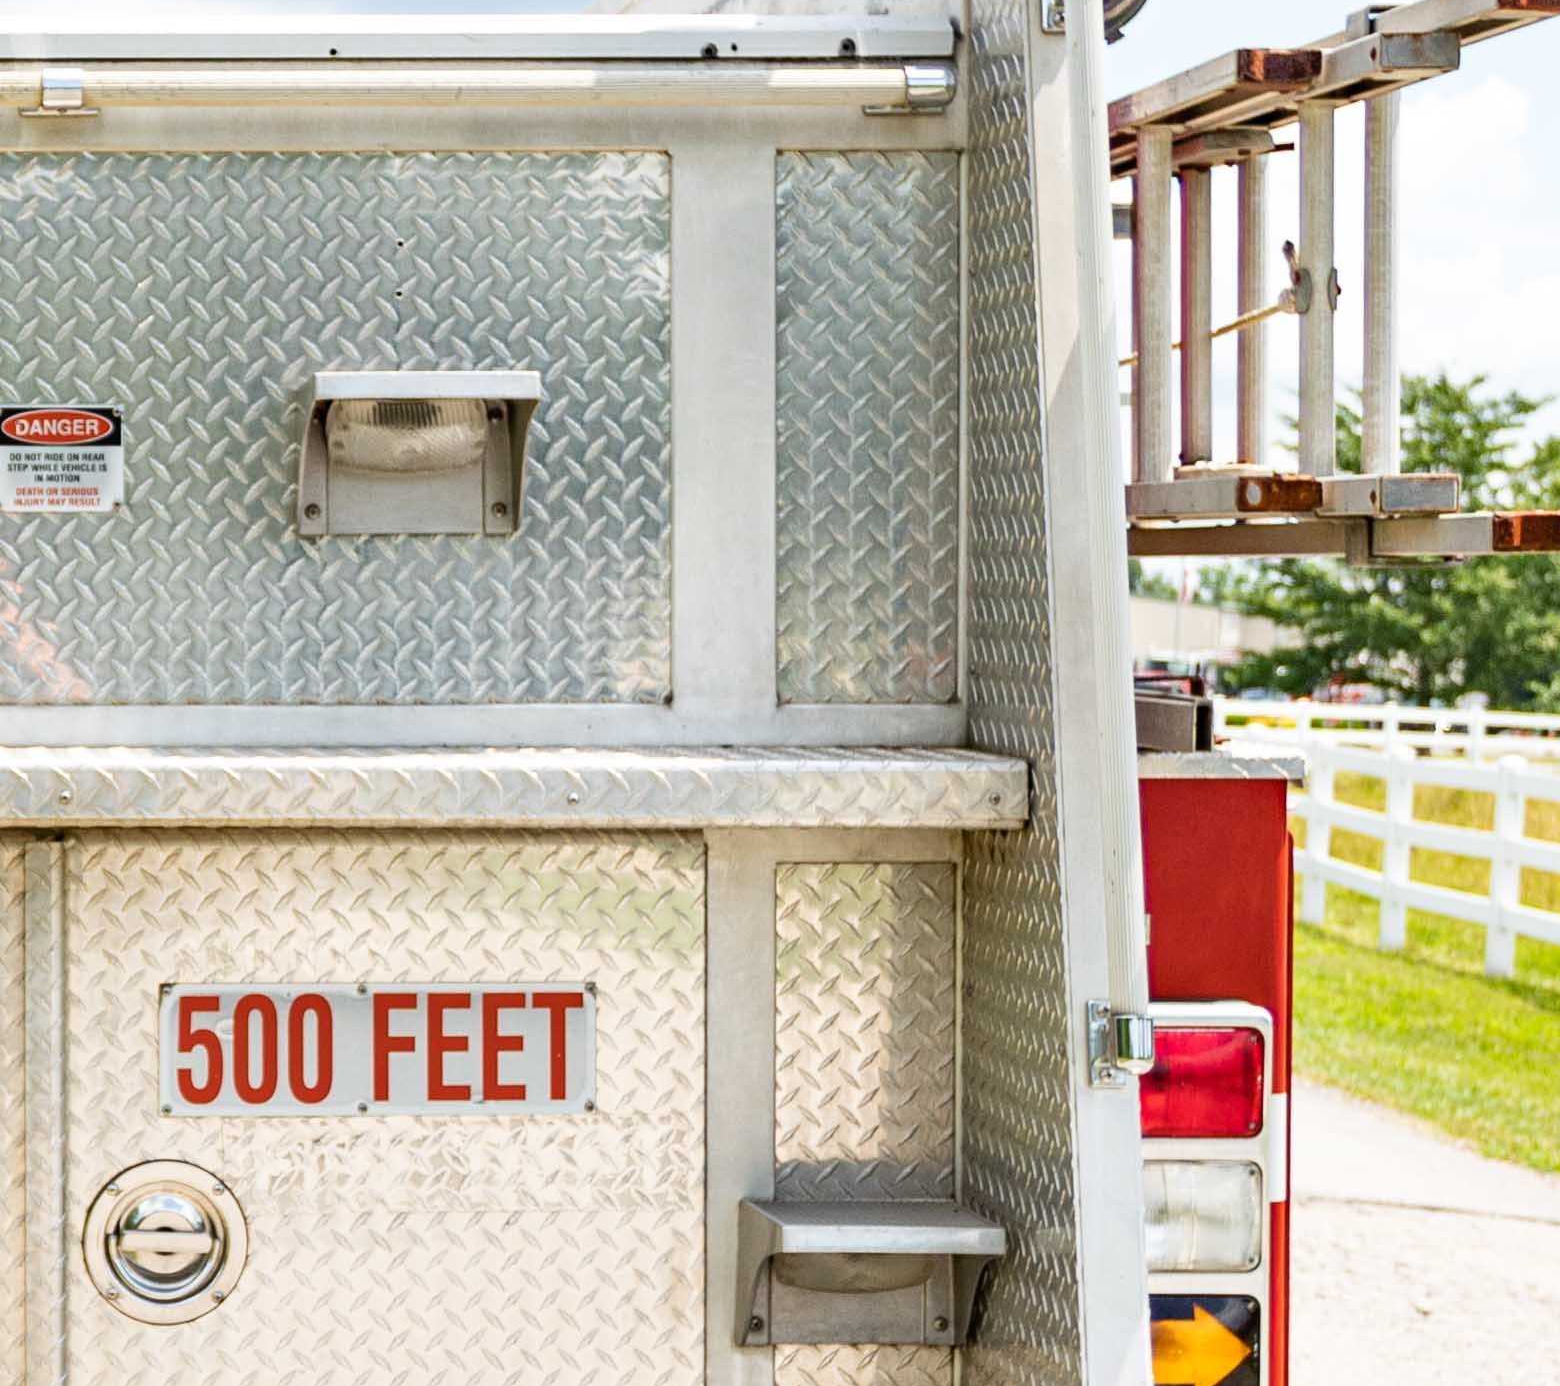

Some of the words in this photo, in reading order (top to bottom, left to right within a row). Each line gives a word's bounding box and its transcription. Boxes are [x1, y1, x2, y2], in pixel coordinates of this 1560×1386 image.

[15, 419, 99, 435] DANGER
[9, 453, 22, 461] DO
[24, 453, 41, 461] NOT
[44, 453, 64, 461] RIDE
[67, 453, 79, 461] ON
[81, 453, 105, 461] REAR
[7, 463, 29, 472] STEP
[31, 463, 58, 472] WHILE
[61, 463, 96, 472] VEHICLE
[99, 463, 108, 472] IS
[34, 474, 43, 483] IN
[46, 474, 80, 483] MOTION
[15, 487, 44, 496] DEATH
[46, 487, 58, 496] OR
[61, 487, 99, 496] SERIOUS
[14, 498, 45, 507] INJURY
[47, 498, 66, 507] MAY
[68, 498, 101, 507] RESULT
[177, 993, 334, 1105] 500
[372, 992, 584, 1102] FEET
